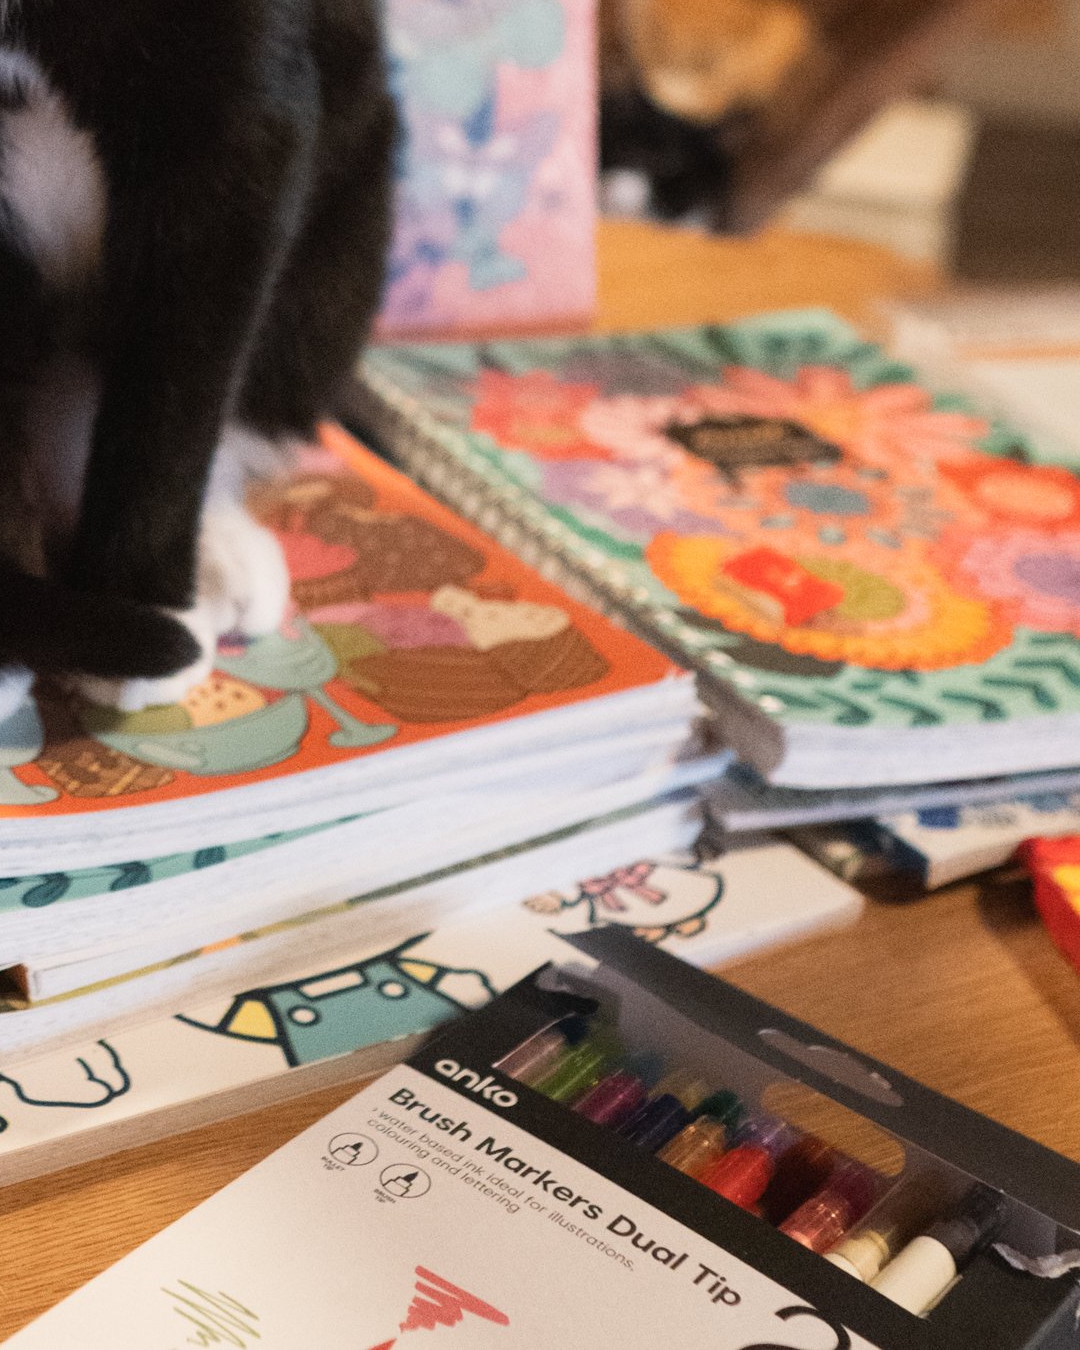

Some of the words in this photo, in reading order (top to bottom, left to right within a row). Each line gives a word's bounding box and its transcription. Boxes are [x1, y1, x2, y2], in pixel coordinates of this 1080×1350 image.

[433, 1058, 519, 1108] anko
[367, 1119, 428, 1160] colouring
[431, 1155, 463, 1177] and
[460, 1171, 520, 1215] lettering
[378, 1109, 416, 1136] water
[419, 1131, 465, 1163] based
[463, 1158, 485, 1177] ink
[486, 1171, 525, 1199] ideal
[524, 1195, 548, 1213] for
[547, 1210, 635, 1272] illustrations.
[388, 1087, 473, 1143] Brush
[474, 1136, 604, 1221] Markers
[606, 1214, 689, 1271] Dual
[693, 1262, 742, 1307] Tip
